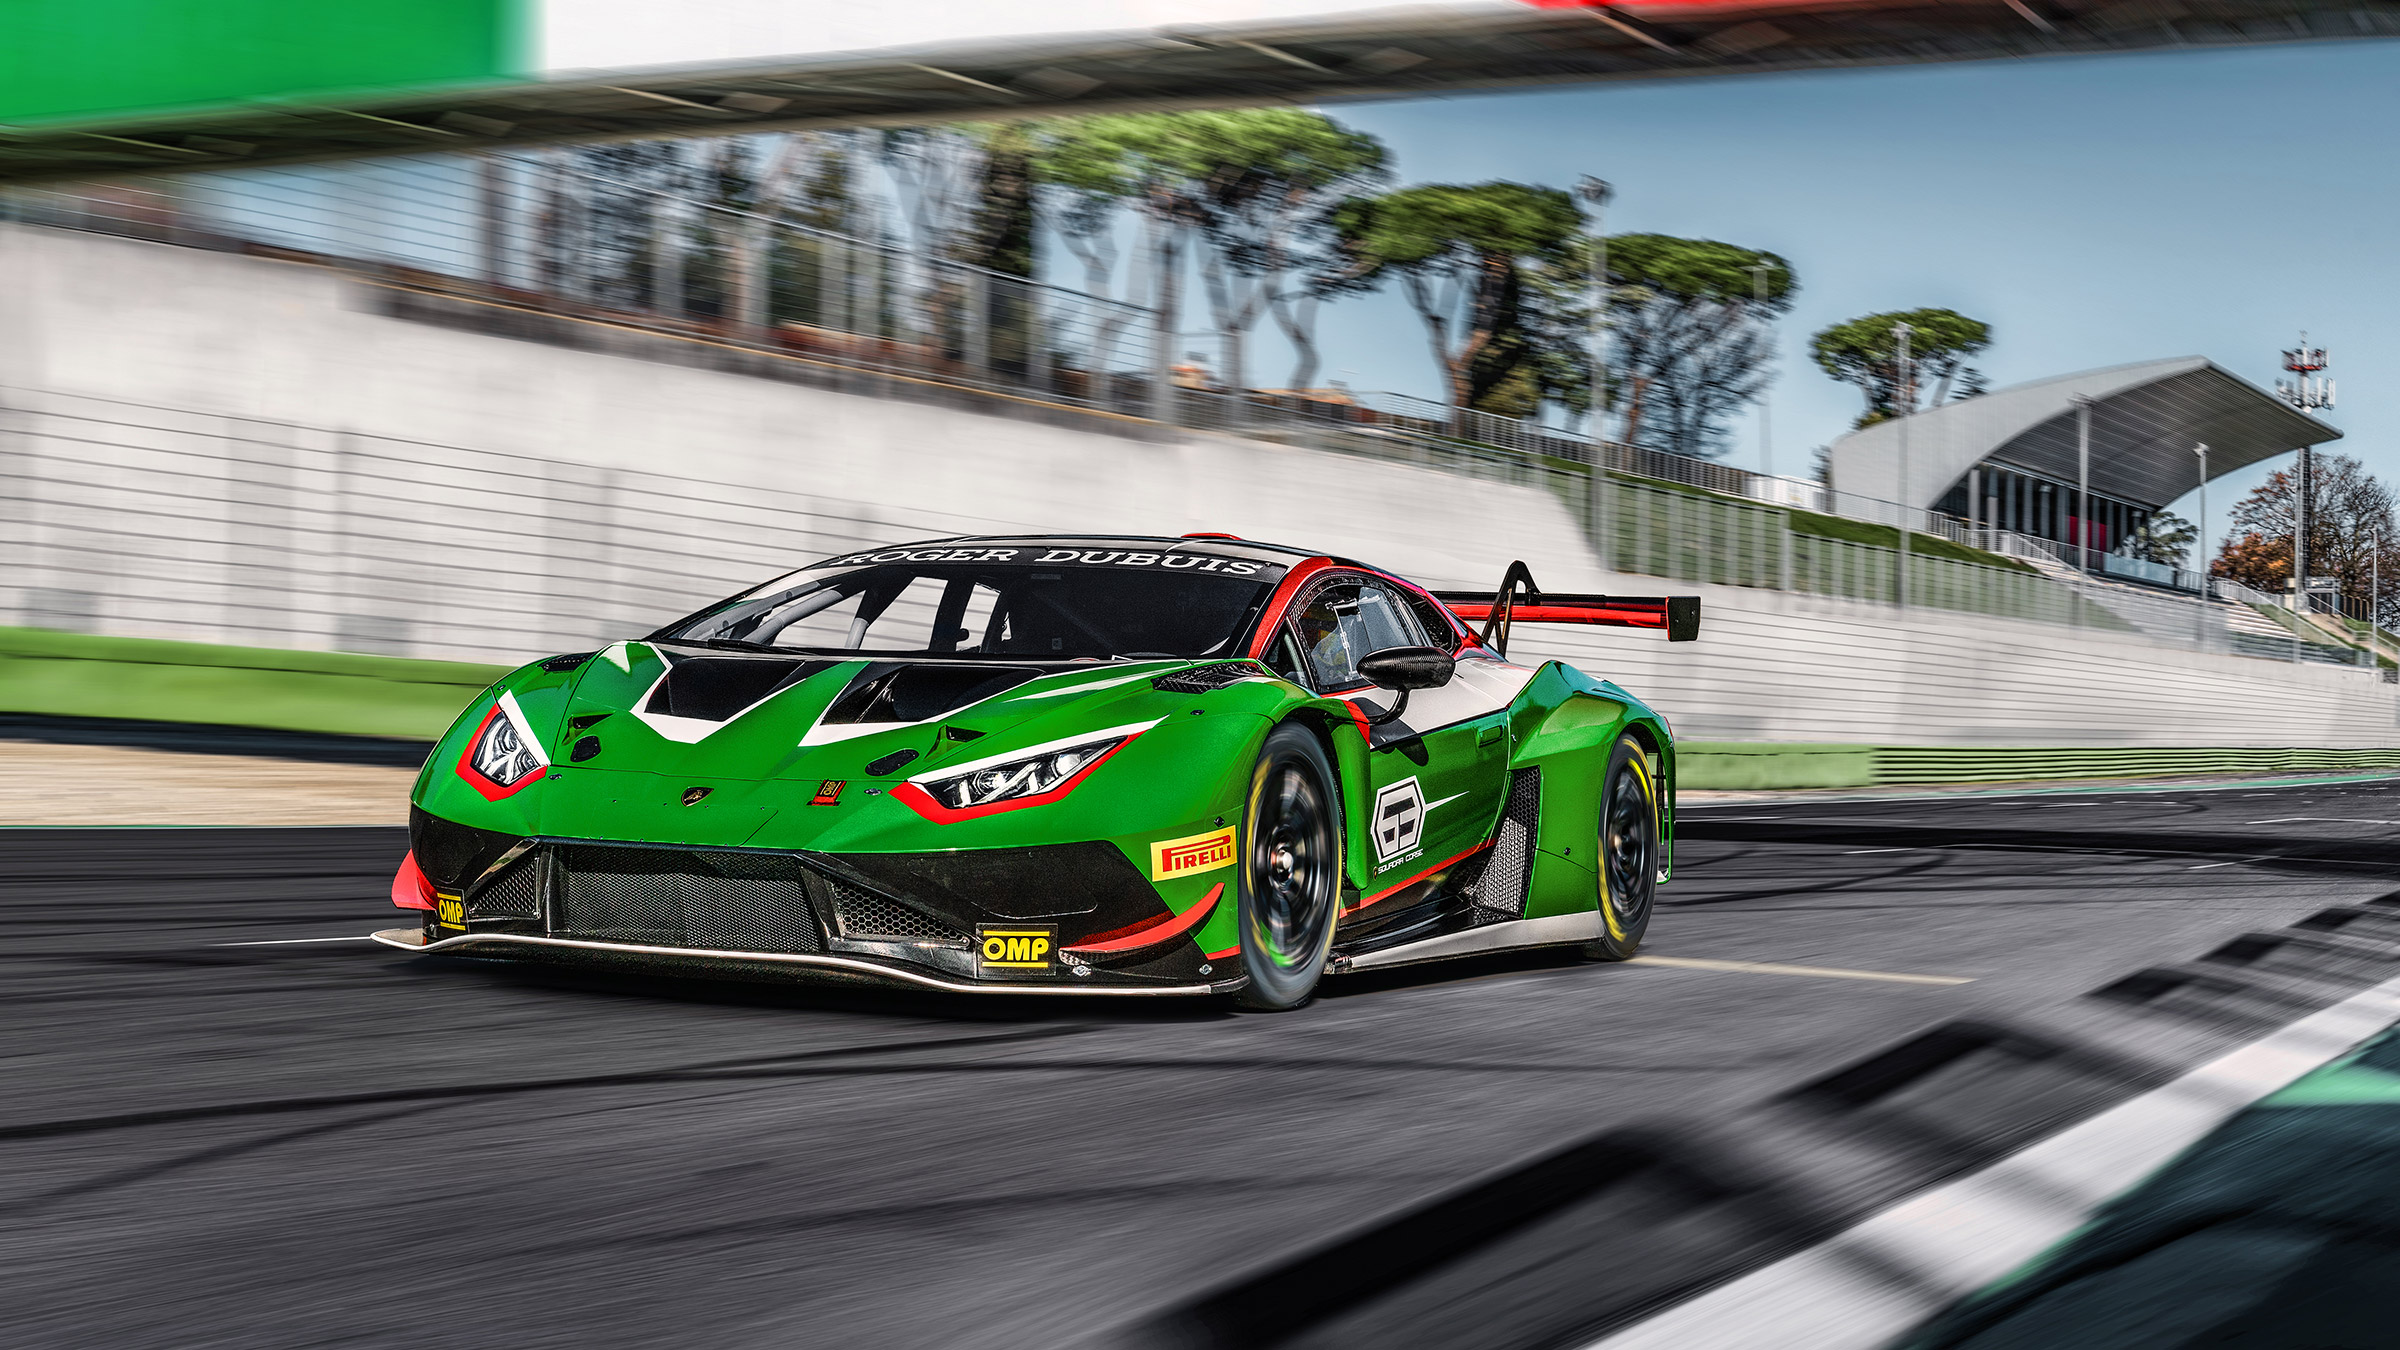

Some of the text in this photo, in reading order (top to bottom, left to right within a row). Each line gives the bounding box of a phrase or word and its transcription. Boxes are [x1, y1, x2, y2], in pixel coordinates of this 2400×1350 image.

[829, 549, 1263, 574] ROGER DUBUIS
[1161, 835, 1231, 873] PIRELLI
[1378, 848, 1424, 874] SQUADRA CORSE
[439, 899, 463, 924] OMP
[983, 937, 1049, 961] OMP
